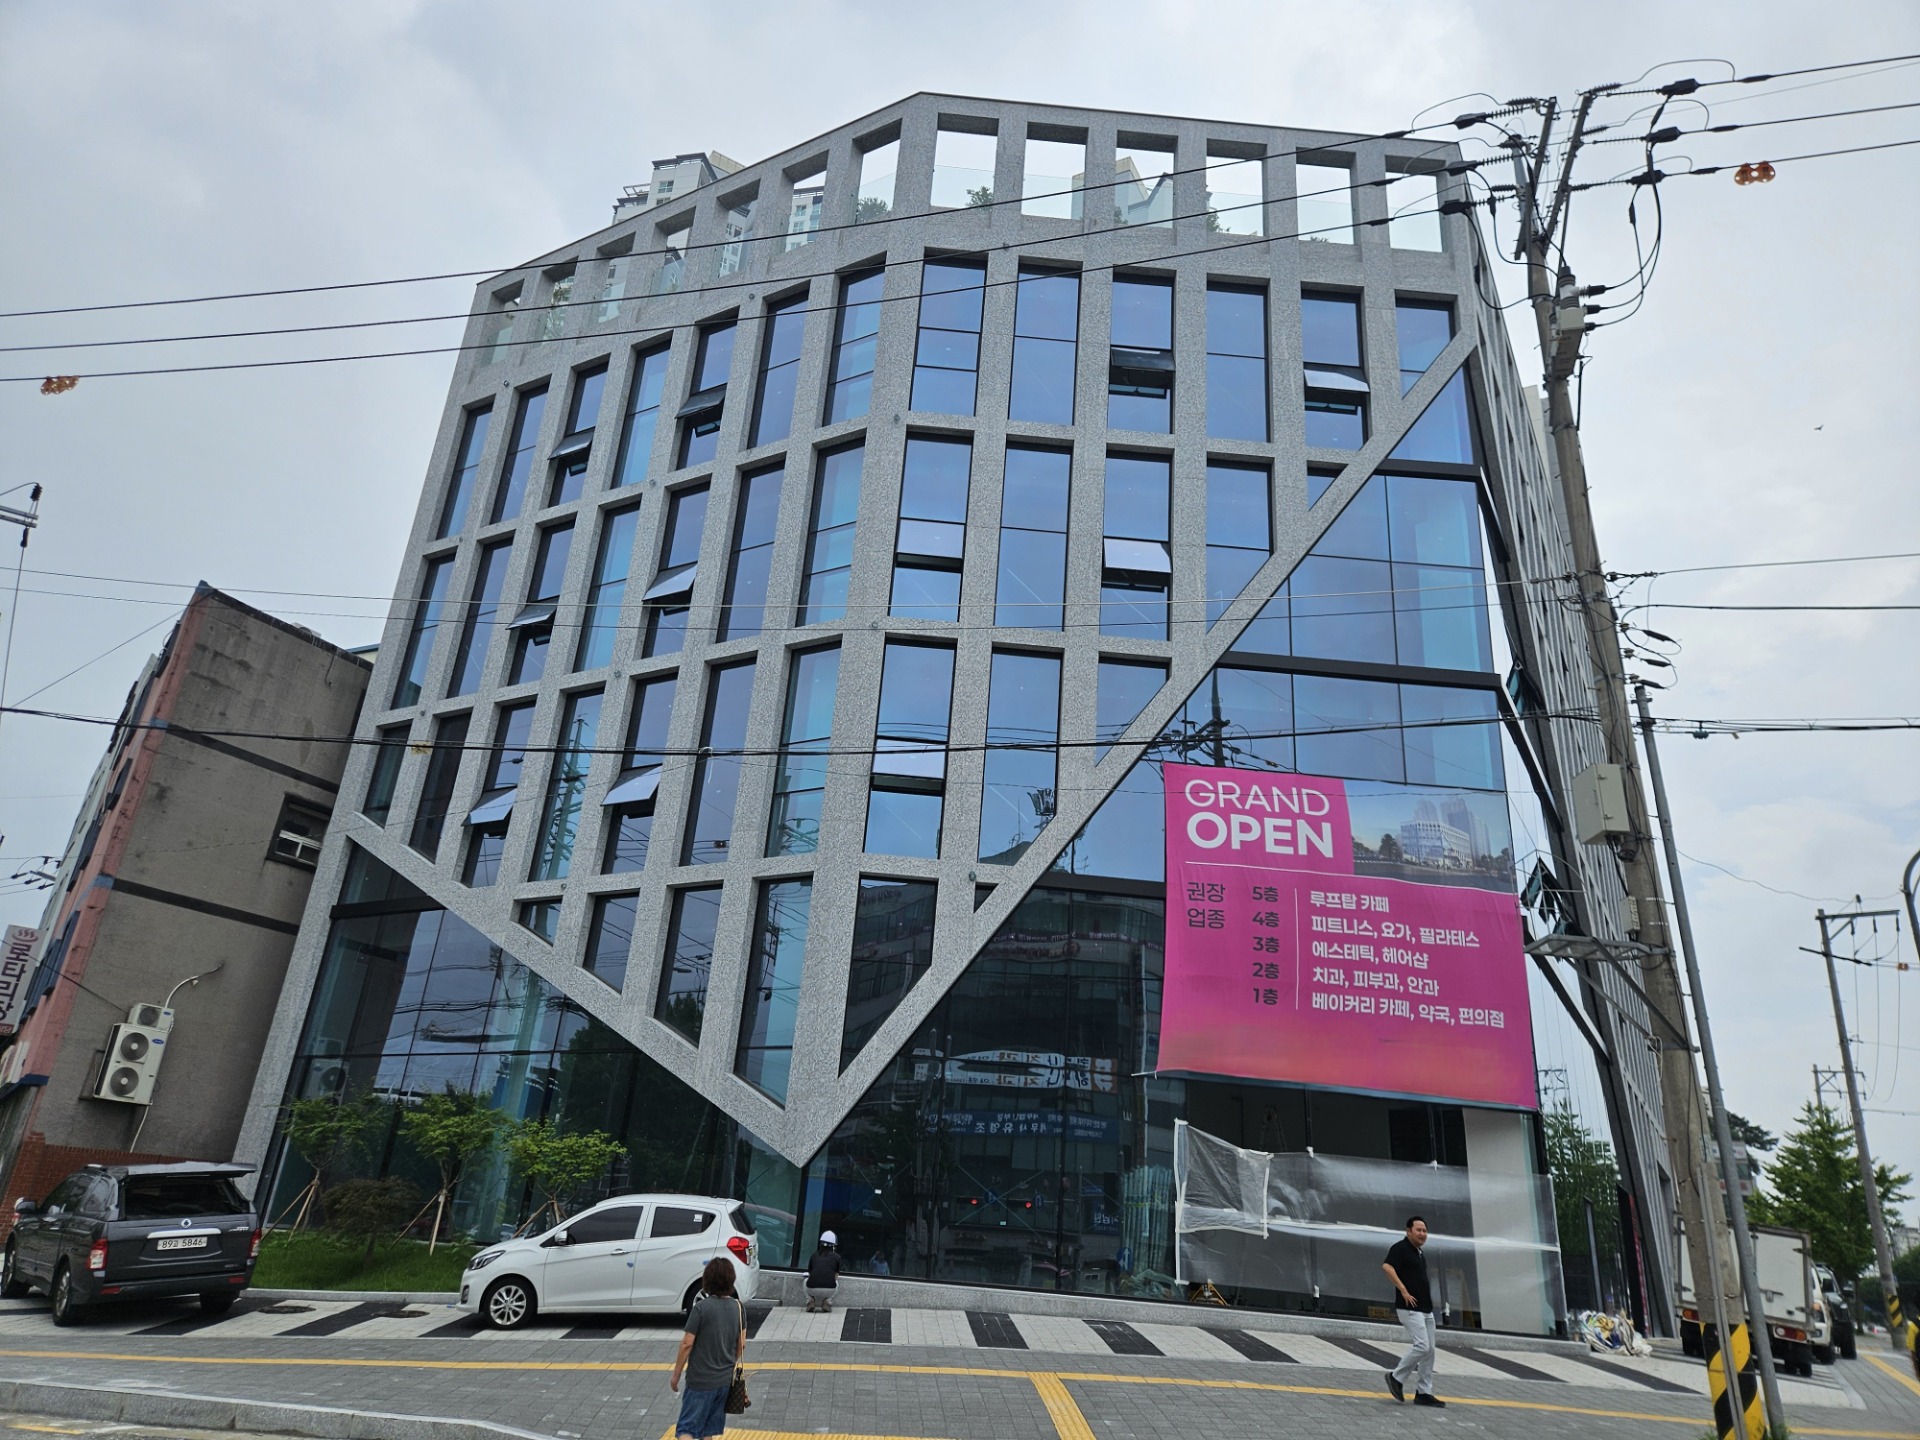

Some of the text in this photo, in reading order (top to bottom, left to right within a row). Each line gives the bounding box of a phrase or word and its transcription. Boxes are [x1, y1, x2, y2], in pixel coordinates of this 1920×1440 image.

[1185, 780, 1329, 817] GRAND
[1187, 811, 1333, 857] OPEN
[1187, 882, 1225, 902] 권장
[1253, 887, 1278, 902] 5층
[1311, 891, 1389, 912] 루프탑 카페
[1188, 908, 1225, 929] 업종
[1253, 912, 1279, 927] 4층
[1312, 916, 1479, 947] 피트니스, 요가, 필라테스
[1253, 937, 1279, 953] 3층
[1313, 942, 1428, 969] 에스테틱, 헤어샵
[1253, 963, 1279, 979] 2층
[1313, 967, 1439, 996] 치과, 피부과, 안과
[1254, 988, 1277, 1005] 1층
[1313, 993, 1503, 1027] 베이커리 카페, 약국, 편의점
[181, 1238, 203, 1247] 5846
